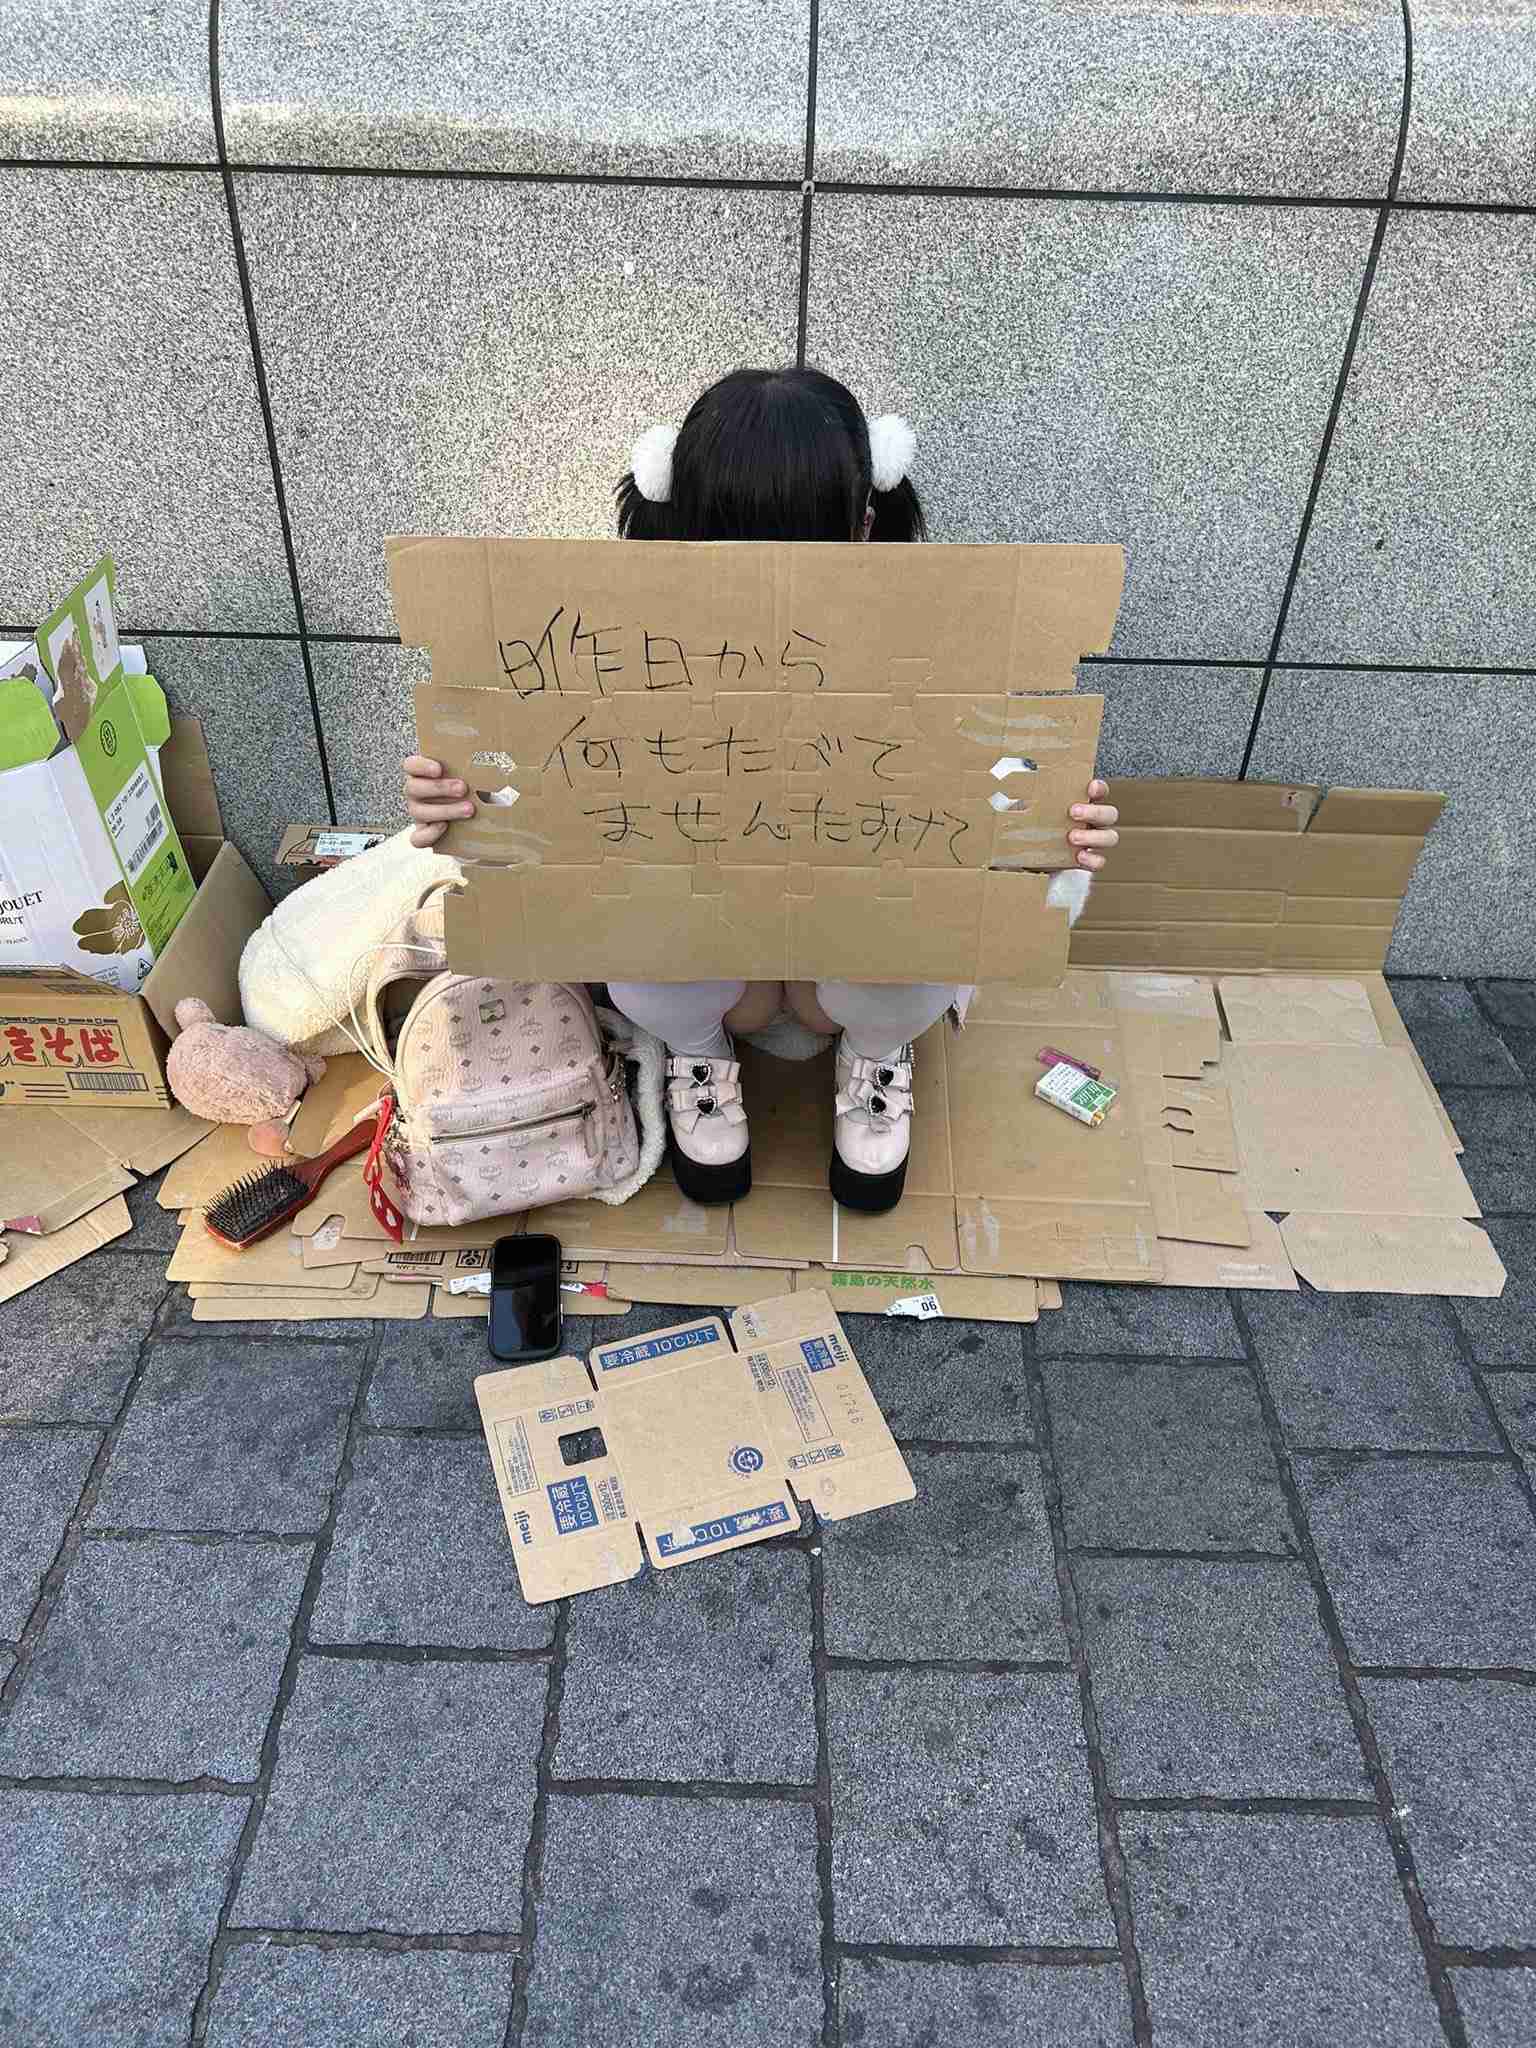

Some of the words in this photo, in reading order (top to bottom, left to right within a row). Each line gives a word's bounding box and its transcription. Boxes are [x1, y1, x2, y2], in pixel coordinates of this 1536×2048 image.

[4, 1026, 120, 1064] きそば
[828, 1334, 850, 1362] meiji
[513, 1510, 533, 1545] meiji
